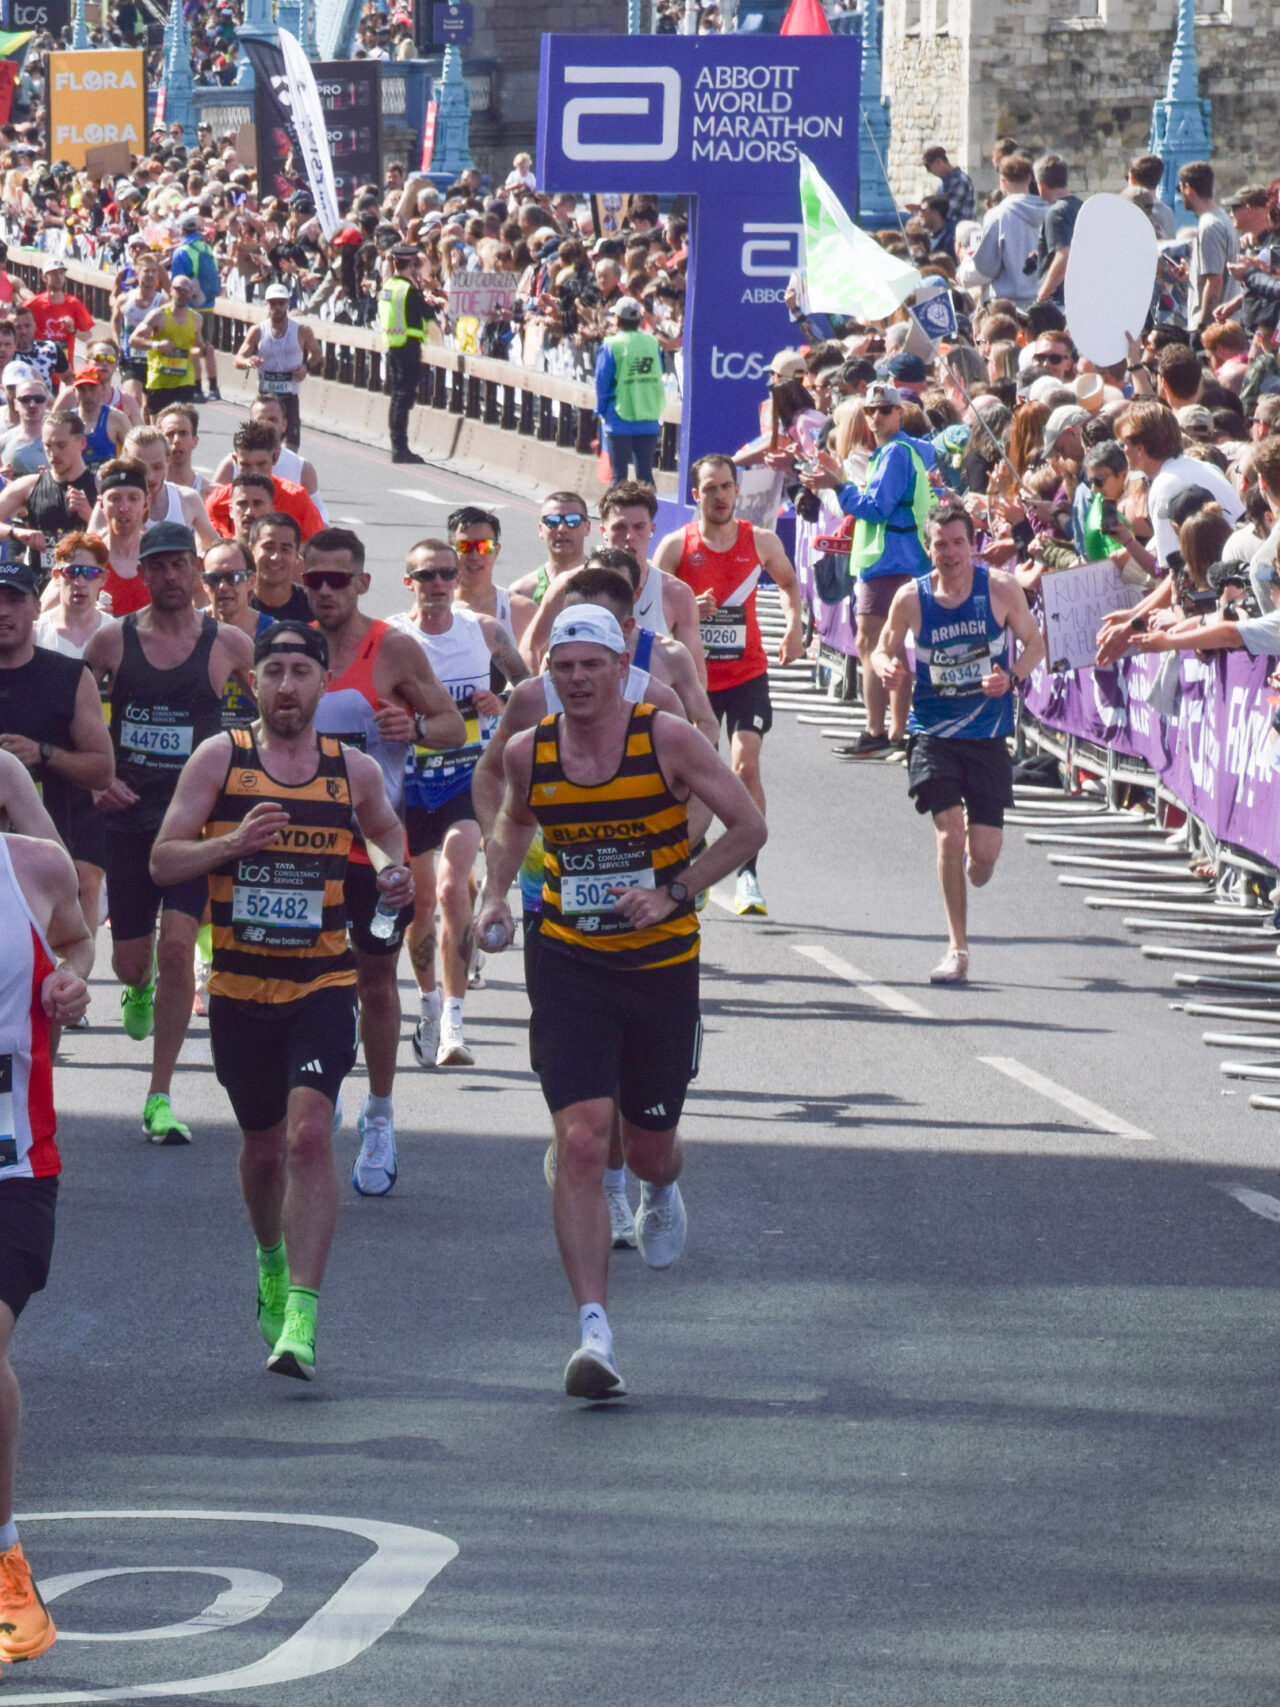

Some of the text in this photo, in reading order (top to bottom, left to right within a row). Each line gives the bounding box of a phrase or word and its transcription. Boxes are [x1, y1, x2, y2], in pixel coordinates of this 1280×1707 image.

[14, 3, 48, 24] tcs
[55, 70, 137, 91] FLORA
[695, 66, 800, 89] ABBOTT
[694, 92, 792, 113] WORLD
[56, 123, 138, 144] FLORA
[693, 116, 843, 138] MARATHON
[692, 140, 797, 162] MAJORS
[450, 290, 481, 315] JOE
[711, 346, 763, 380] tcs
[931, 620, 987, 645] ARMAGH
[125, 703, 150, 722] tcs
[130, 729, 181, 750] 44763
[552, 822, 646, 842] BLAYDON
[562, 852, 595, 871] tcs
[597, 847, 618, 855] TATA
[597, 850, 646, 863] CONSULTANCY
[238, 860, 271, 883] tcs
[274, 869, 320, 879] CONSULTANCY
[275, 862, 296, 870] TATA
[598, 861, 630, 870] SERVICES
[273, 877, 304, 886] SERVICES
[247, 894, 309, 921] 52482
